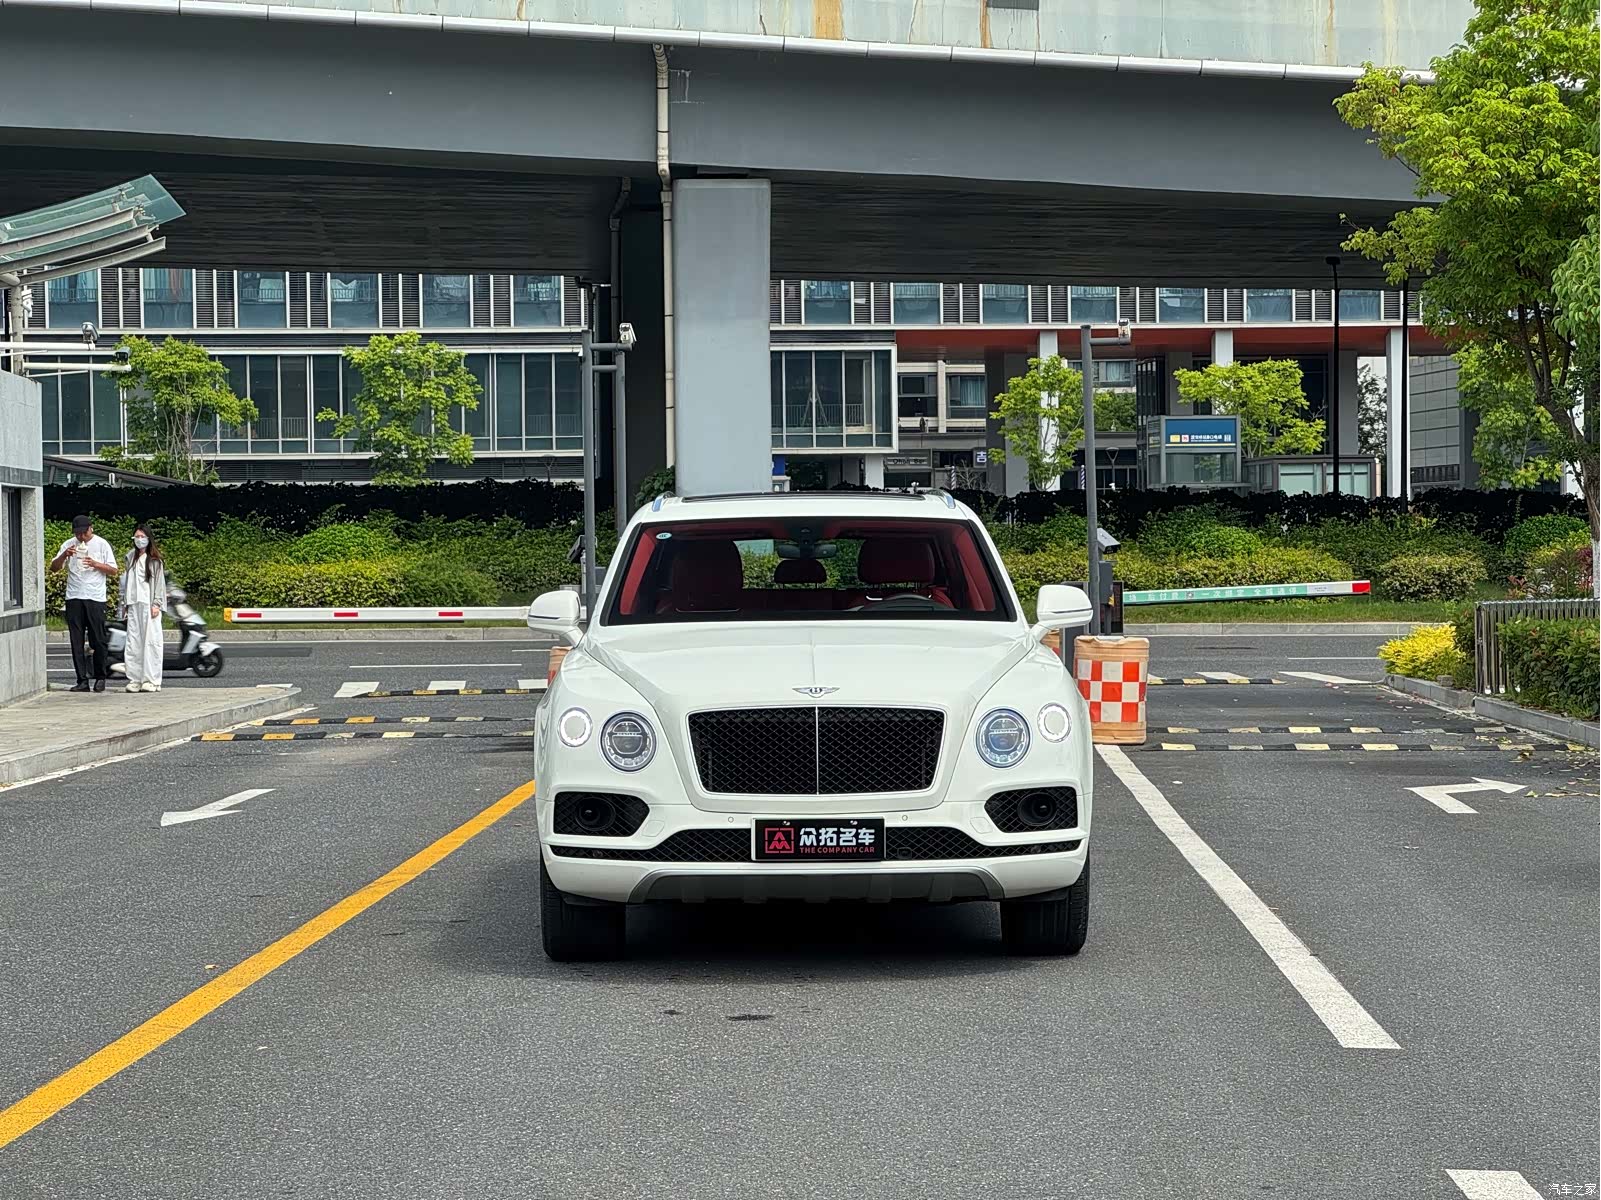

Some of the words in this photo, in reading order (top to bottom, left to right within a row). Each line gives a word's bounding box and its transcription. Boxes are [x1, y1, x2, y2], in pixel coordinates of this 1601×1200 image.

[799, 827, 875, 847] 众拓名车
[799, 846, 816, 854] THE
[817, 846, 858, 854] COMPANY
[858, 846, 876, 854] CAR
